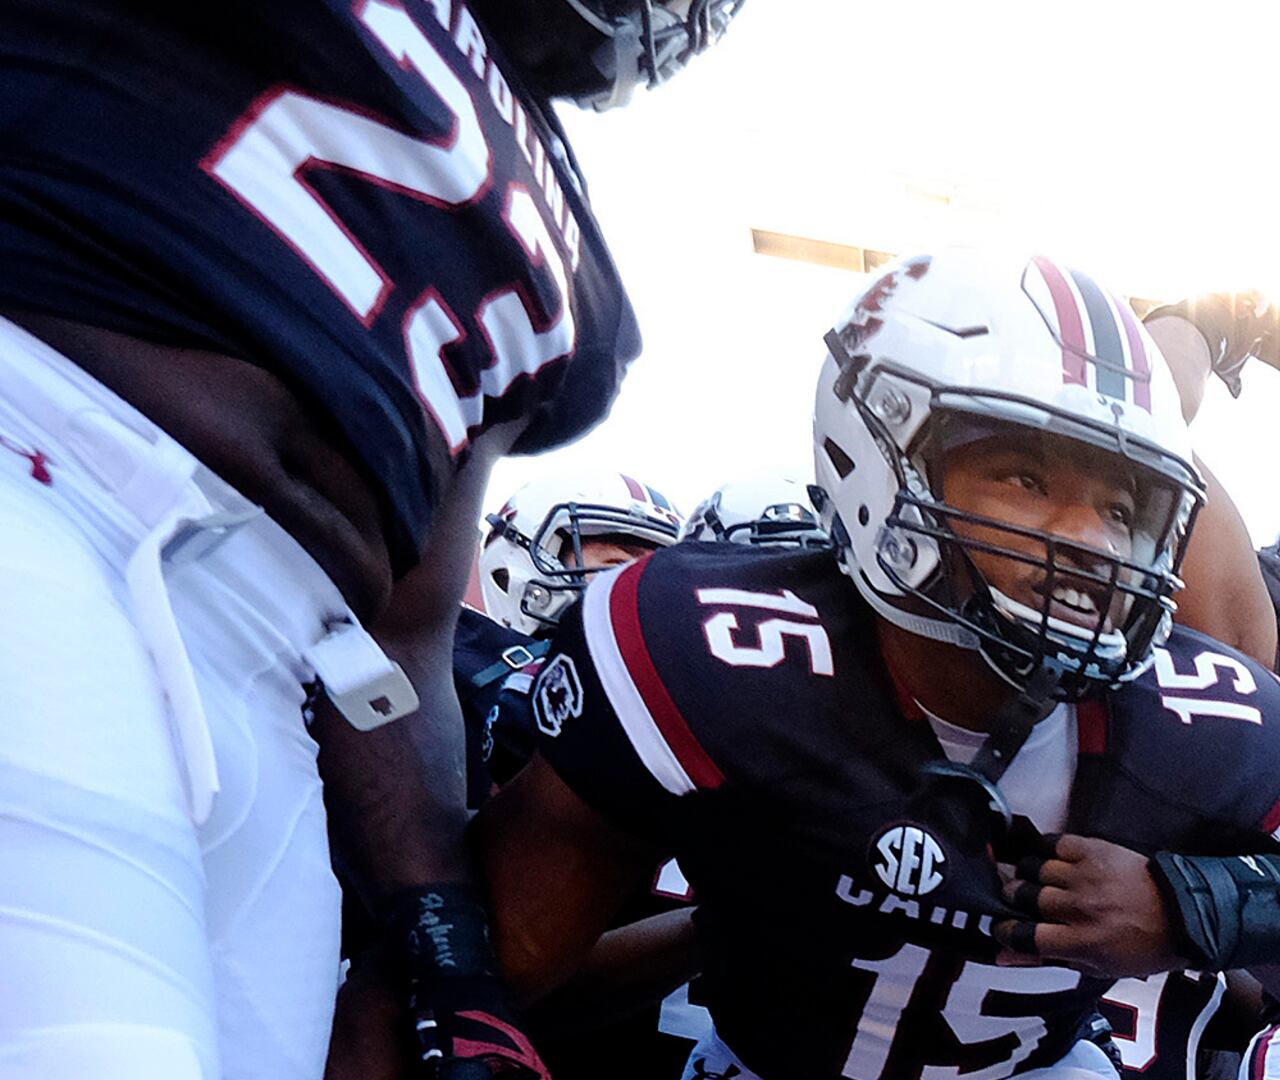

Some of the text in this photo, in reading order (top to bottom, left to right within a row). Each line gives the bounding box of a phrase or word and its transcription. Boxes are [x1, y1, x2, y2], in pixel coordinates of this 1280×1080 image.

[430, 0, 580, 274] ROLINA
[199, 0, 576, 456] 23
[696, 587, 835, 677] 15
[1150, 645, 1263, 726] 15
[874, 826, 946, 896] SEC
